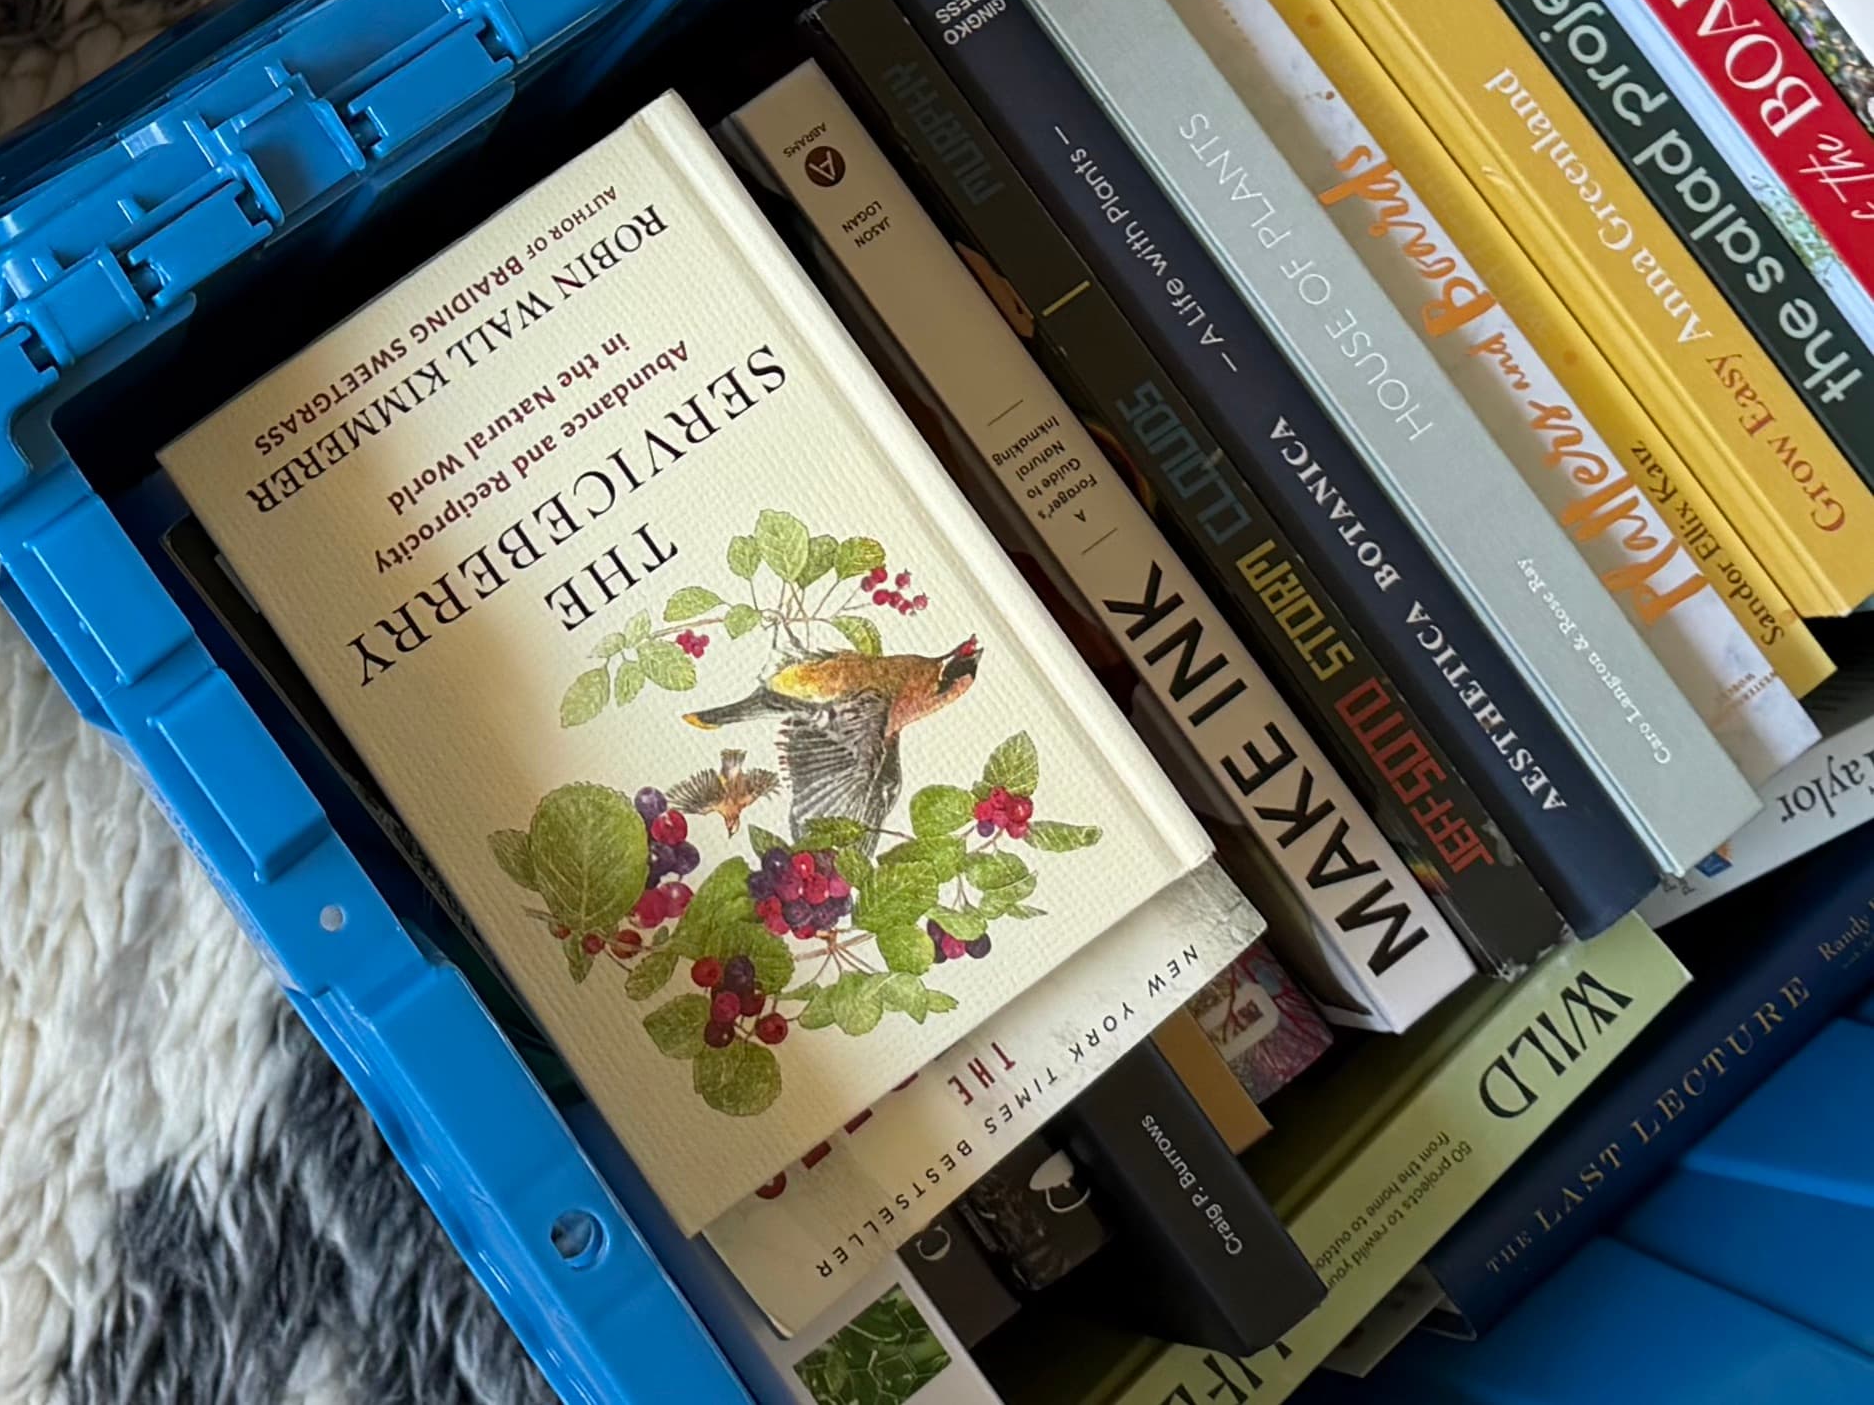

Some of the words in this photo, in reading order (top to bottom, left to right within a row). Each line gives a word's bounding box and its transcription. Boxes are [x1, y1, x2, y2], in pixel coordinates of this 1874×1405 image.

[782, 121, 825, 157] ABRAMS
[1483, 67, 1633, 249] Greenland
[547, 185, 615, 240] AUTHOR
[840, 200, 881, 232] LOGAN
[1070, 147, 1129, 222] Plants
[1179, 112, 1291, 248] PLANTS
[1632, 128, 1784, 292] salad
[525, 236, 546, 259] OF
[550, 204, 667, 299] ROBIN
[853, 216, 889, 247] JASON
[1125, 220, 1167, 275] with
[1319, 145, 1496, 337] Boards
[408, 255, 523, 343] BRAIDING
[1166, 277, 1205, 325] Life
[1279, 258, 1331, 304] OF
[1631, 246, 1712, 341] Anna
[445, 291, 552, 367] WALL
[600, 332, 629, 355] in
[1200, 322, 1224, 343] A
[1476, 316, 1550, 399] and
[1779, 297, 1862, 402] the
[253, 338, 406, 456] SWEETGRASS
[556, 353, 598, 387] the
[559, 340, 687, 437] Abundance
[1324, 307, 1433, 440] HOUSE
[1705, 352, 1776, 436] Easy
[244, 360, 448, 512] KIMMERER
[462, 385, 555, 460] Natural
[510, 434, 556, 478] and
[990, 415, 1059, 466] Inkmaking
[385, 454, 463, 516] World
[1014, 440, 1064, 481] Natural
[1036, 473, 1096, 519] Forager's
[1040, 457, 1080, 488] Guide
[1630, 440, 1678, 503] Katz
[1767, 435, 1845, 531] Grow
[334, 344, 784, 689] SERVICEBERRY
[373, 470, 510, 574] Reciprocity
[1270, 415, 1400, 590] BOTANICA
[1527, 400, 1714, 622] Platters
[1675, 500, 1721, 561] Ellix
[543, 522, 677, 630] THE
[1235, 538, 1354, 679] STORM
[1517, 557, 1546, 592] Ray
[1718, 561, 1784, 644] Sandor
[1102, 559, 1247, 726] INK
[1542, 591, 1577, 634] Rose
[1406, 600, 1566, 808] AESTHETICA
[1588, 650, 1642, 722] Langton
[1639, 721, 1671, 763] Caro
[1219, 720, 1428, 975] MAKE
[946, 1041, 1014, 1105] THE
[1478, 970, 1632, 1118] WILD
[1141, 1114, 1196, 1188] Burrows
[1486, 1230, 1532, 1272] THE
[1534, 1142, 1621, 1230] LAST
[1631, 976, 1809, 1142] LECTURE
[1191, 1185, 1209, 1206] P.
[1205, 1202, 1242, 1254] Craig
